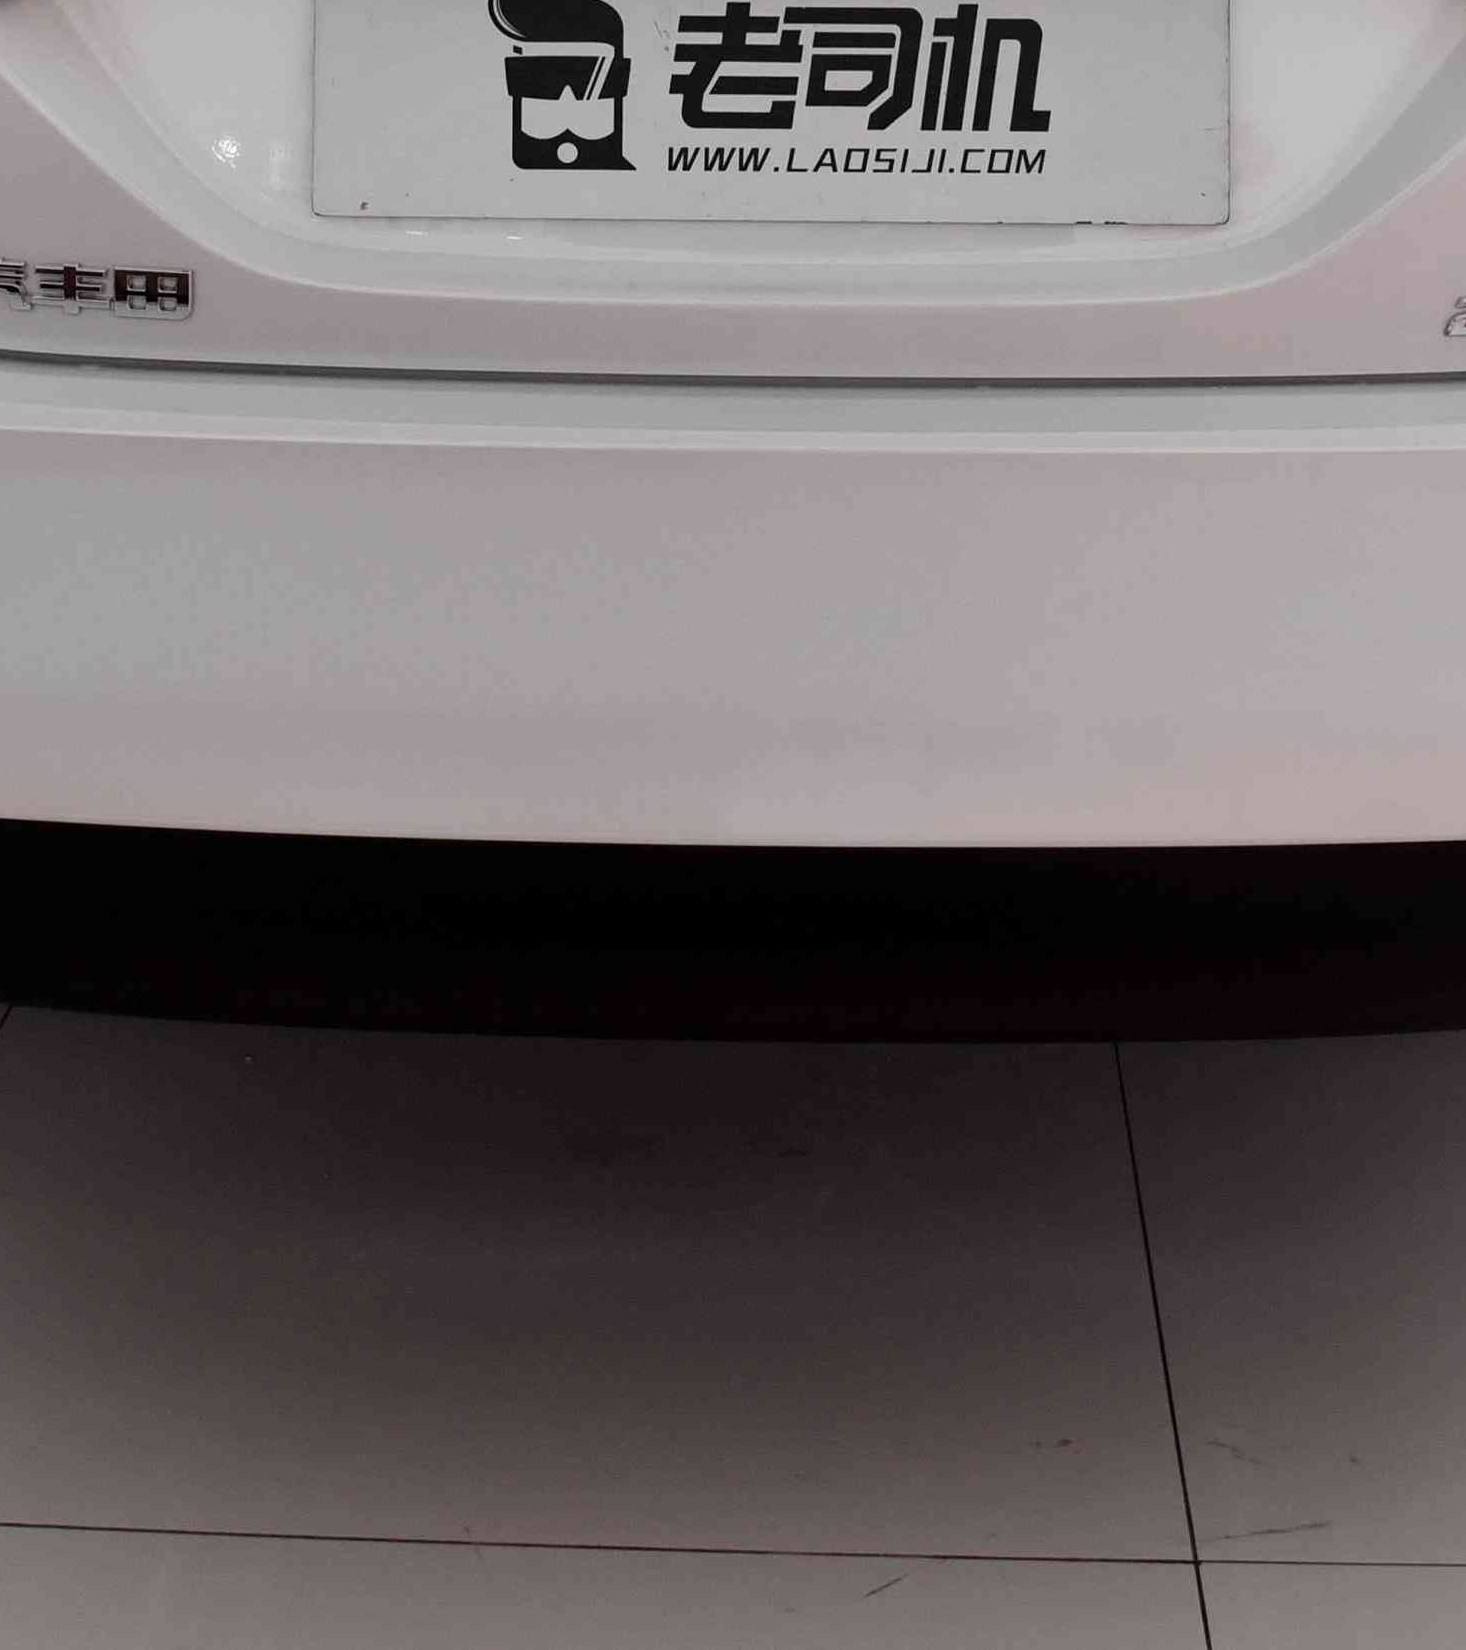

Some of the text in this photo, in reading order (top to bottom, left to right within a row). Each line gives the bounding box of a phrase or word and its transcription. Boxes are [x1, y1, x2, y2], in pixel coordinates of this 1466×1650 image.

[668, 1, 1052, 133] 老司机
[666, 146, 1046, 174] WWW.LAOSIJI.COM
